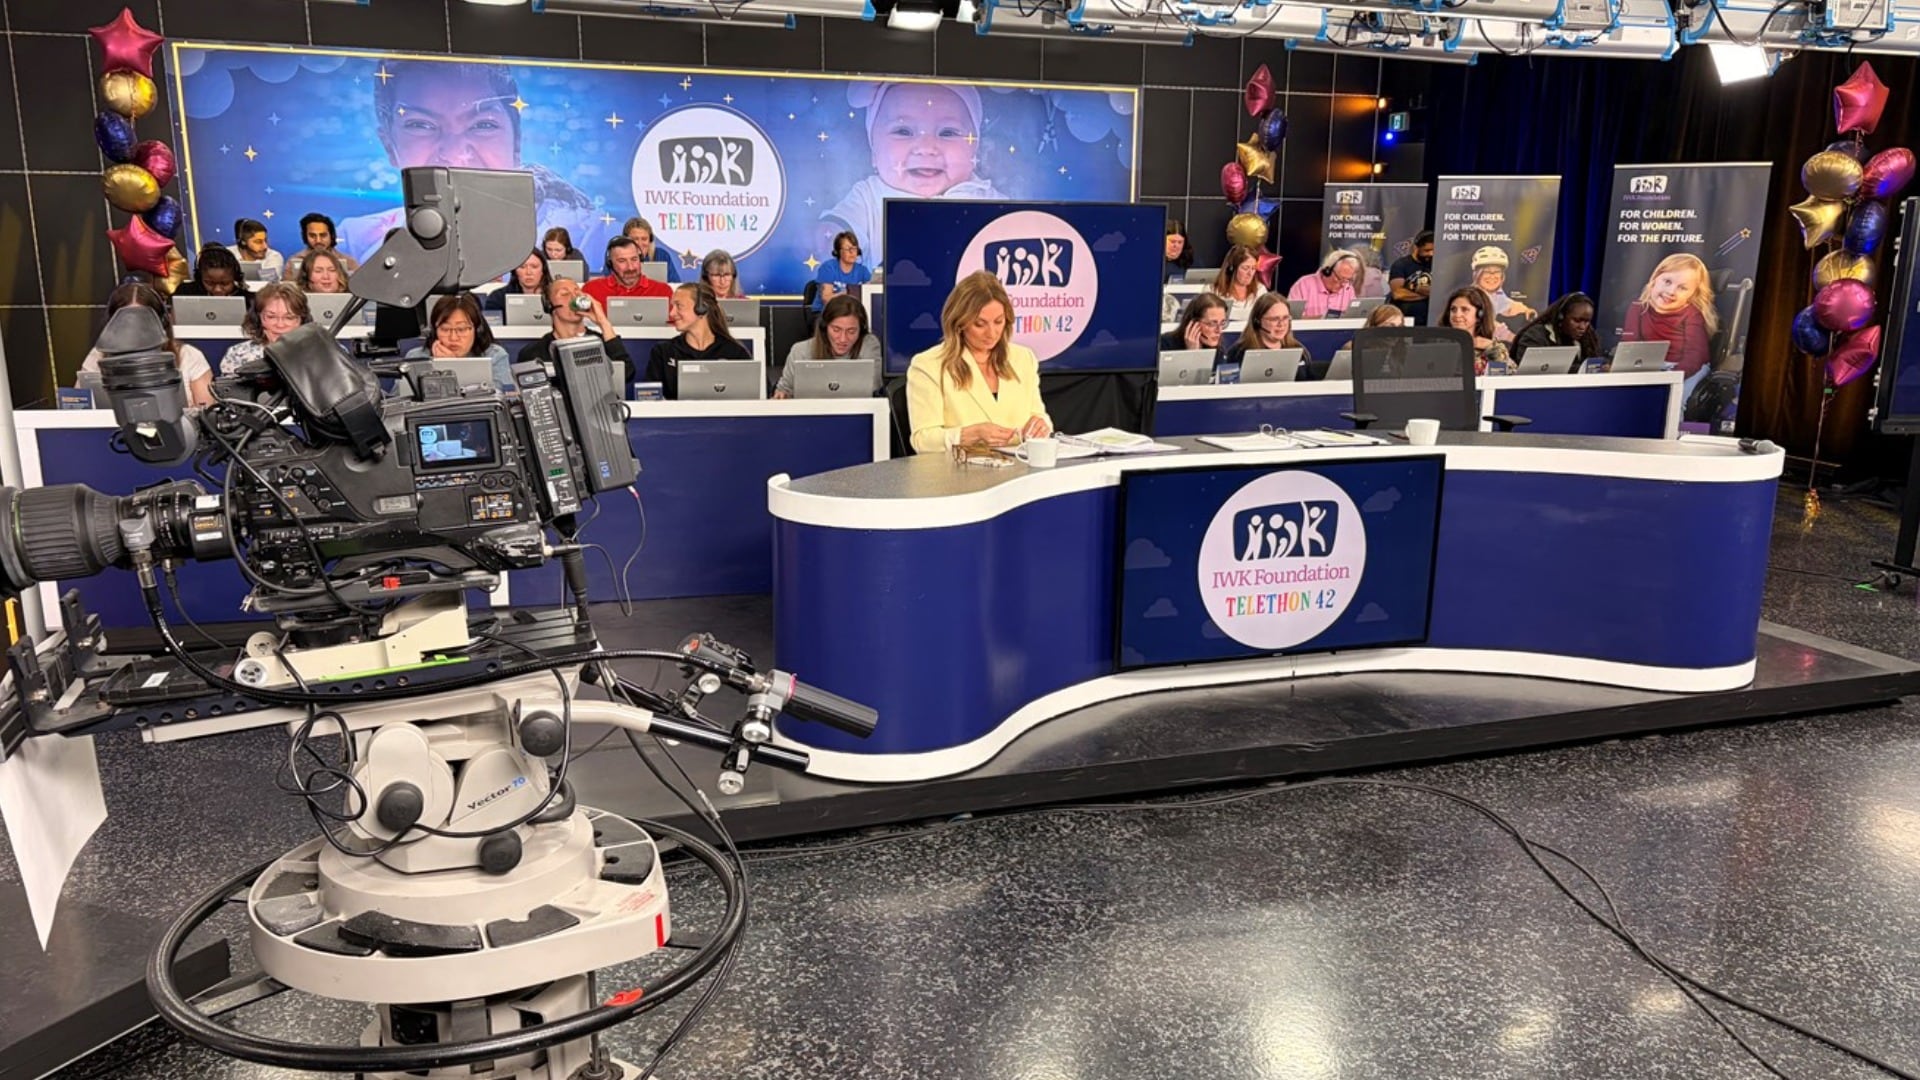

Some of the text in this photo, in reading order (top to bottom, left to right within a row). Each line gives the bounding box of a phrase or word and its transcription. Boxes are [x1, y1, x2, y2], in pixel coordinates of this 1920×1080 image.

[645, 190, 769, 207] IWK Foundation
[1444, 213, 1505, 221] FOR CHILDREN.
[1620, 209, 1697, 219] FOR CHILDREN.
[659, 212, 758, 231] TELETHON 42
[1444, 223, 1495, 231] FOR WOMEN.
[1619, 222, 1684, 231] FOR WOMEN.
[1442, 233, 1512, 241] FOR THE FUTURE.
[1617, 234, 1705, 243] FOR THE FUTURE.
[1015, 315, 1073, 334] THON 42
[1212, 563, 1350, 589] IWK Foundation
[1225, 588, 1336, 617] TELETHON 42
[467, 776, 526, 809] Vector 70
